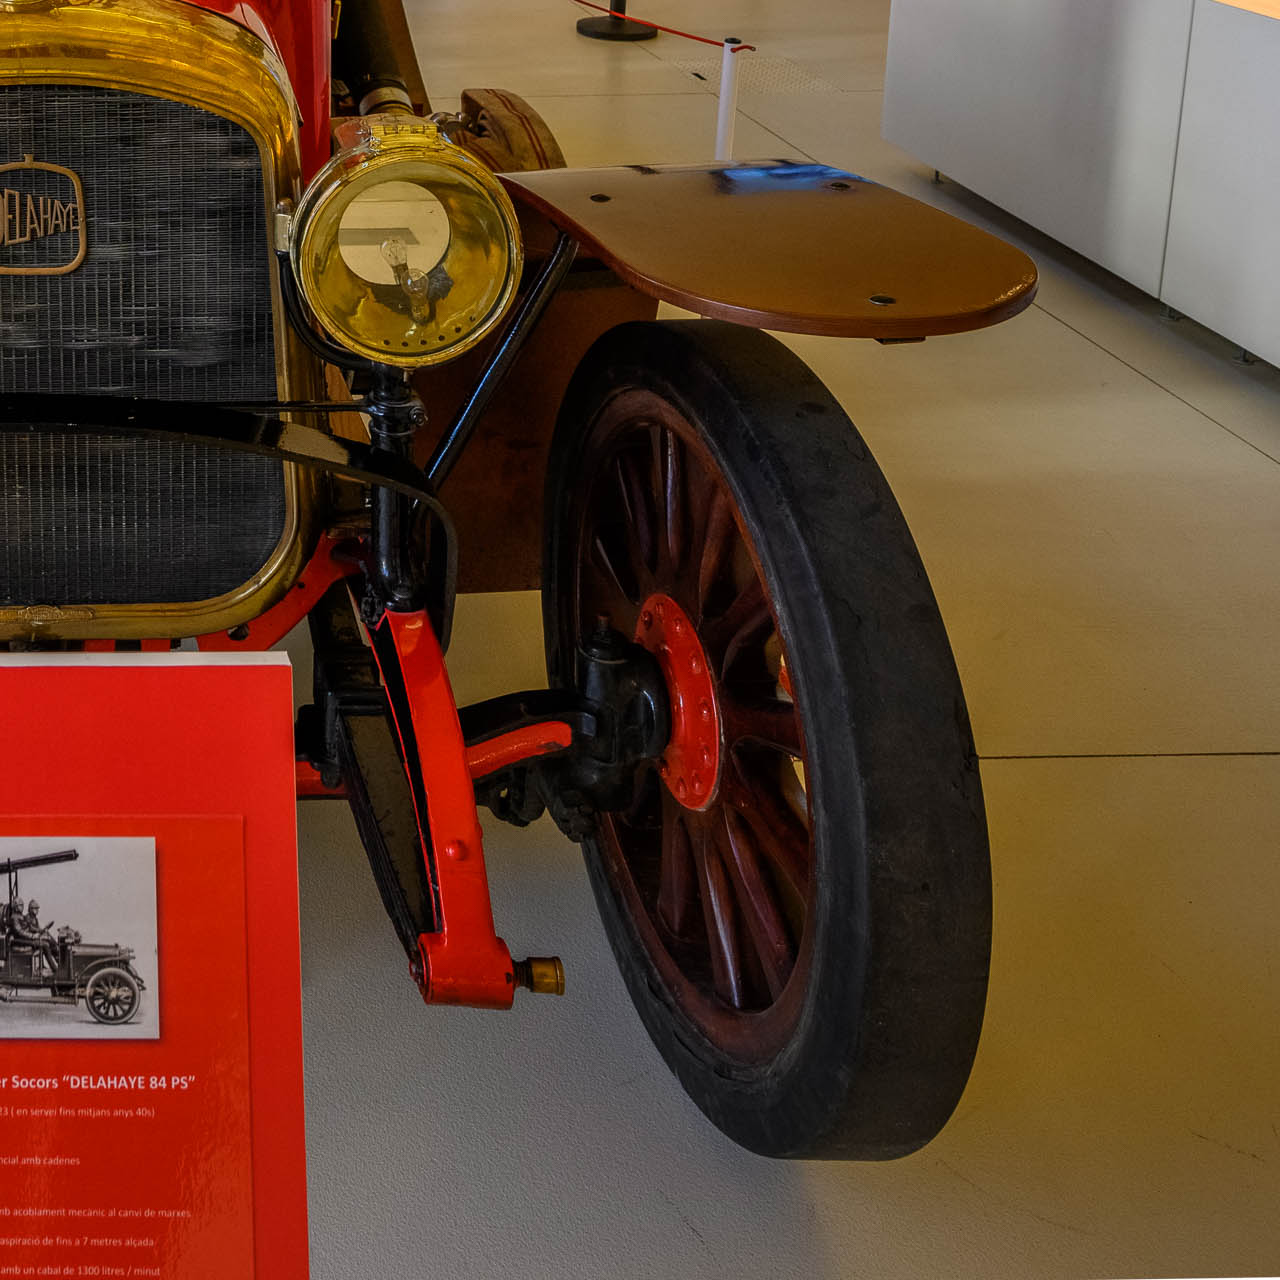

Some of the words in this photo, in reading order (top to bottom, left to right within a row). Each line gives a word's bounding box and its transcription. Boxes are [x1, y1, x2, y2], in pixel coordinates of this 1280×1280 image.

[11, 1075, 58, 1089] Socors
[62, 1075, 145, 1089] “DELAHAYE
[149, 1075, 167, 1089] 84
[16, 1108, 28, 1116] en
[30, 1107, 56, 1116] servei
[59, 1107, 75, 1116] fins
[78, 1107, 110, 1118] mitjans
[113, 1109, 133, 1118] anys
[136, 1108, 155, 1118] 40s)
[21, 1155, 41, 1165] amb
[43, 1155, 80, 1165] cadenes
[13, 1207, 65, 1217] acoblament
[107, 1208, 116, 1217] al
[118, 1208, 142, 1217] canvi
[144, 1208, 155, 1218] de
[0, 1236, 40, 1247] aspiració
[42, 1236, 53, 1246] de
[56, 1236, 72, 1246] fins
[82, 1237, 88, 1246] 7
[90, 1238, 122, 1246] metres
[125, 1237, 154, 1248] alçada
[0, 1265, 20, 1275] amb
[23, 1267, 35, 1275] un
[37, 1266, 61, 1275] cabal
[63, 1266, 75, 1275] de
[78, 1267, 100, 1275] 1300
[101, 1266, 125, 1275] litres
[134, 1266, 161, 1276] minut
